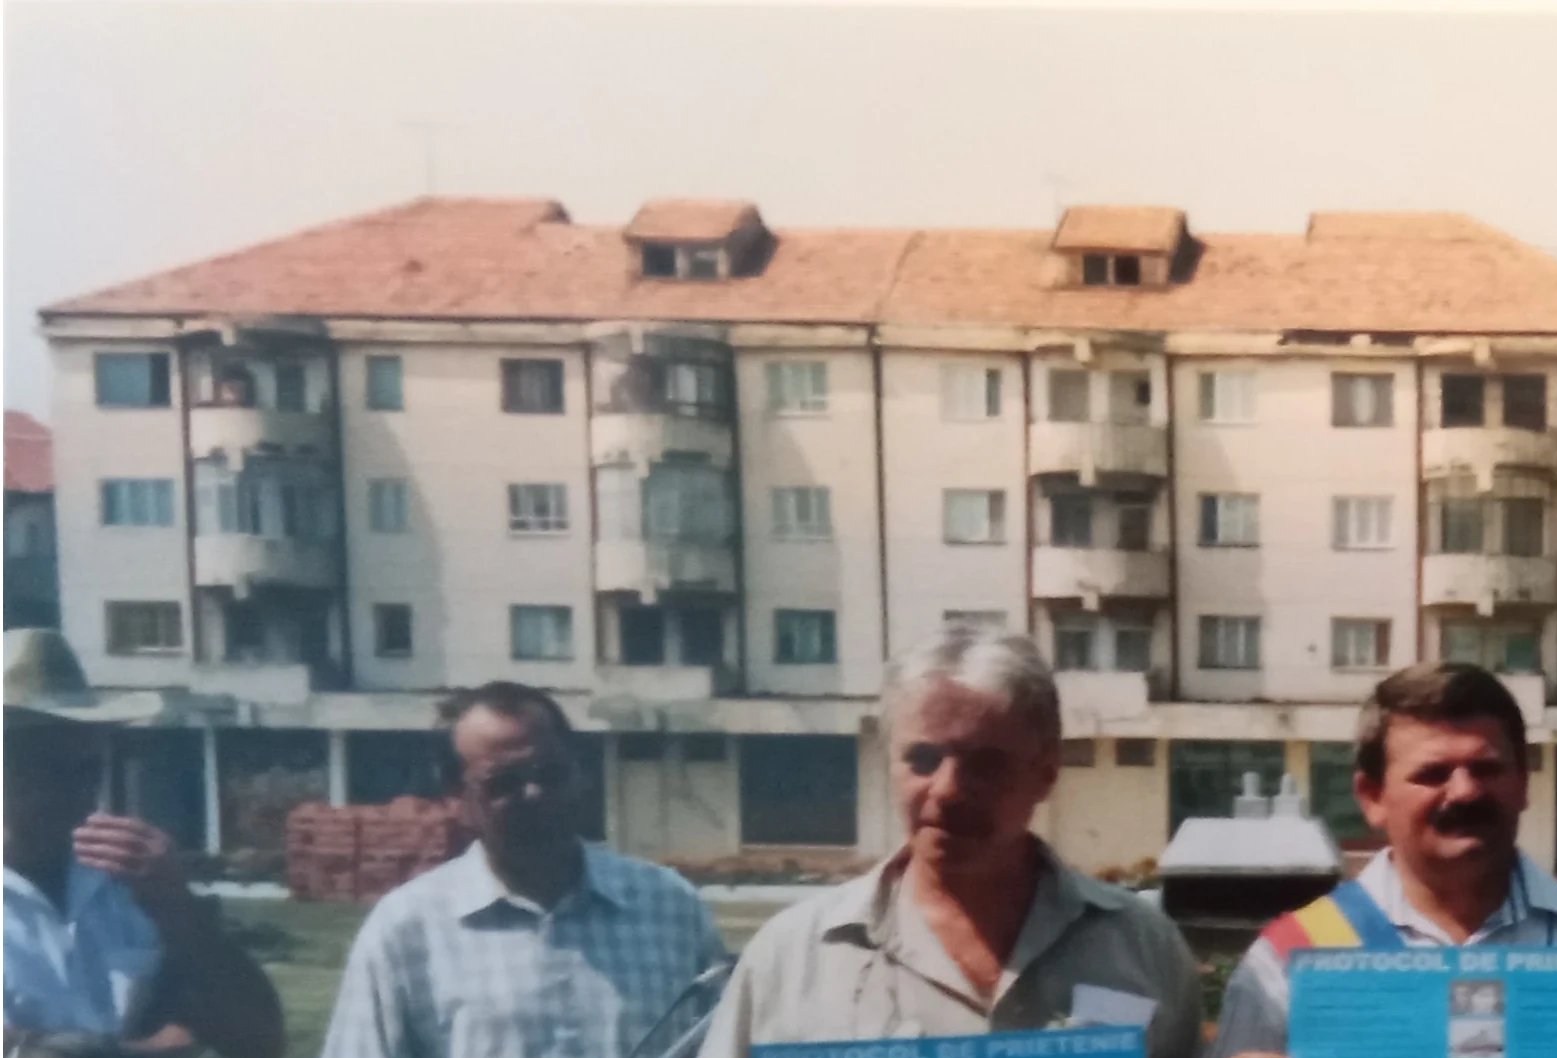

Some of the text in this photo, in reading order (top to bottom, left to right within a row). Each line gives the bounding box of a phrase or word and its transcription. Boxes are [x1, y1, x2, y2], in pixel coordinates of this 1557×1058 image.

[1296, 952, 1450, 972] PROTOCOL
[1459, 952, 1498, 972] DE
[988, 1031, 1138, 1058] PRIETENIE
